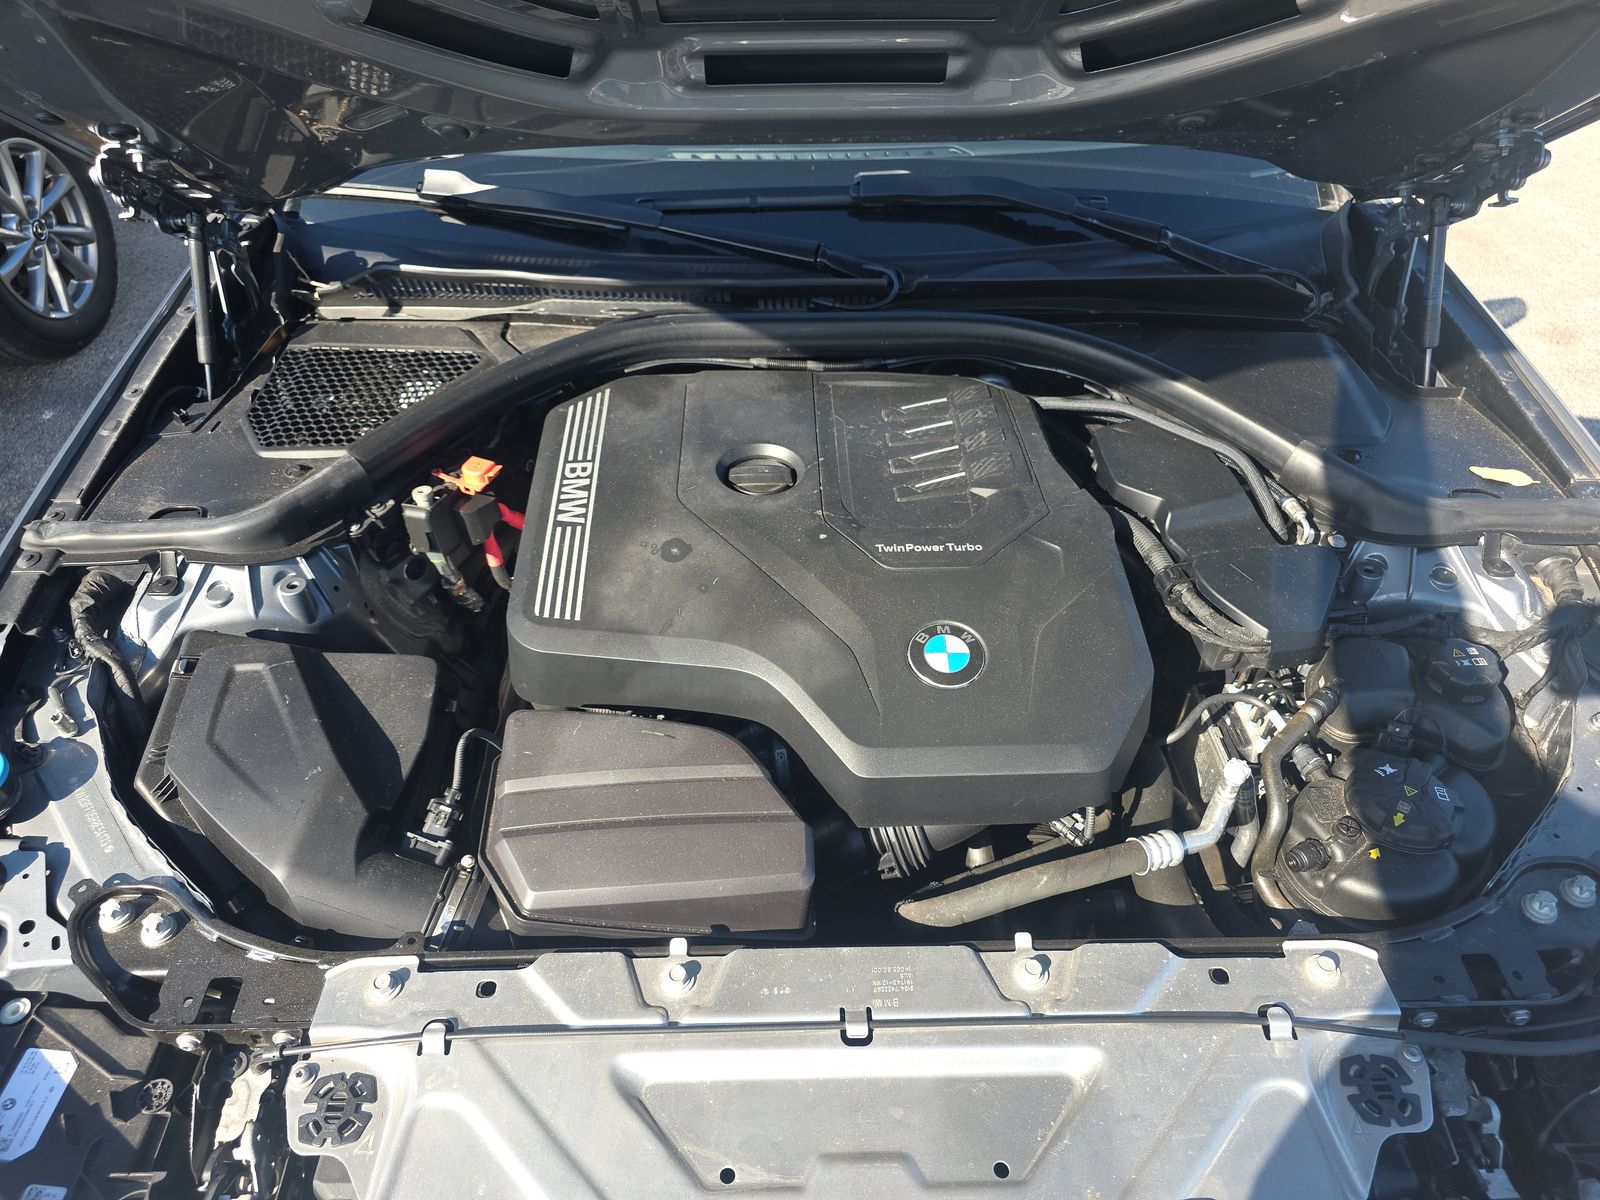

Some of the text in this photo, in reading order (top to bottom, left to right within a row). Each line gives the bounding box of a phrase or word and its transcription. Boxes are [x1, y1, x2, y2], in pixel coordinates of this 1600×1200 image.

[556, 462, 593, 523] BMW
[875, 543, 983, 552] TwinPower Turbo
[915, 625, 976, 644] BMW
[872, 998, 899, 1008] BMW
